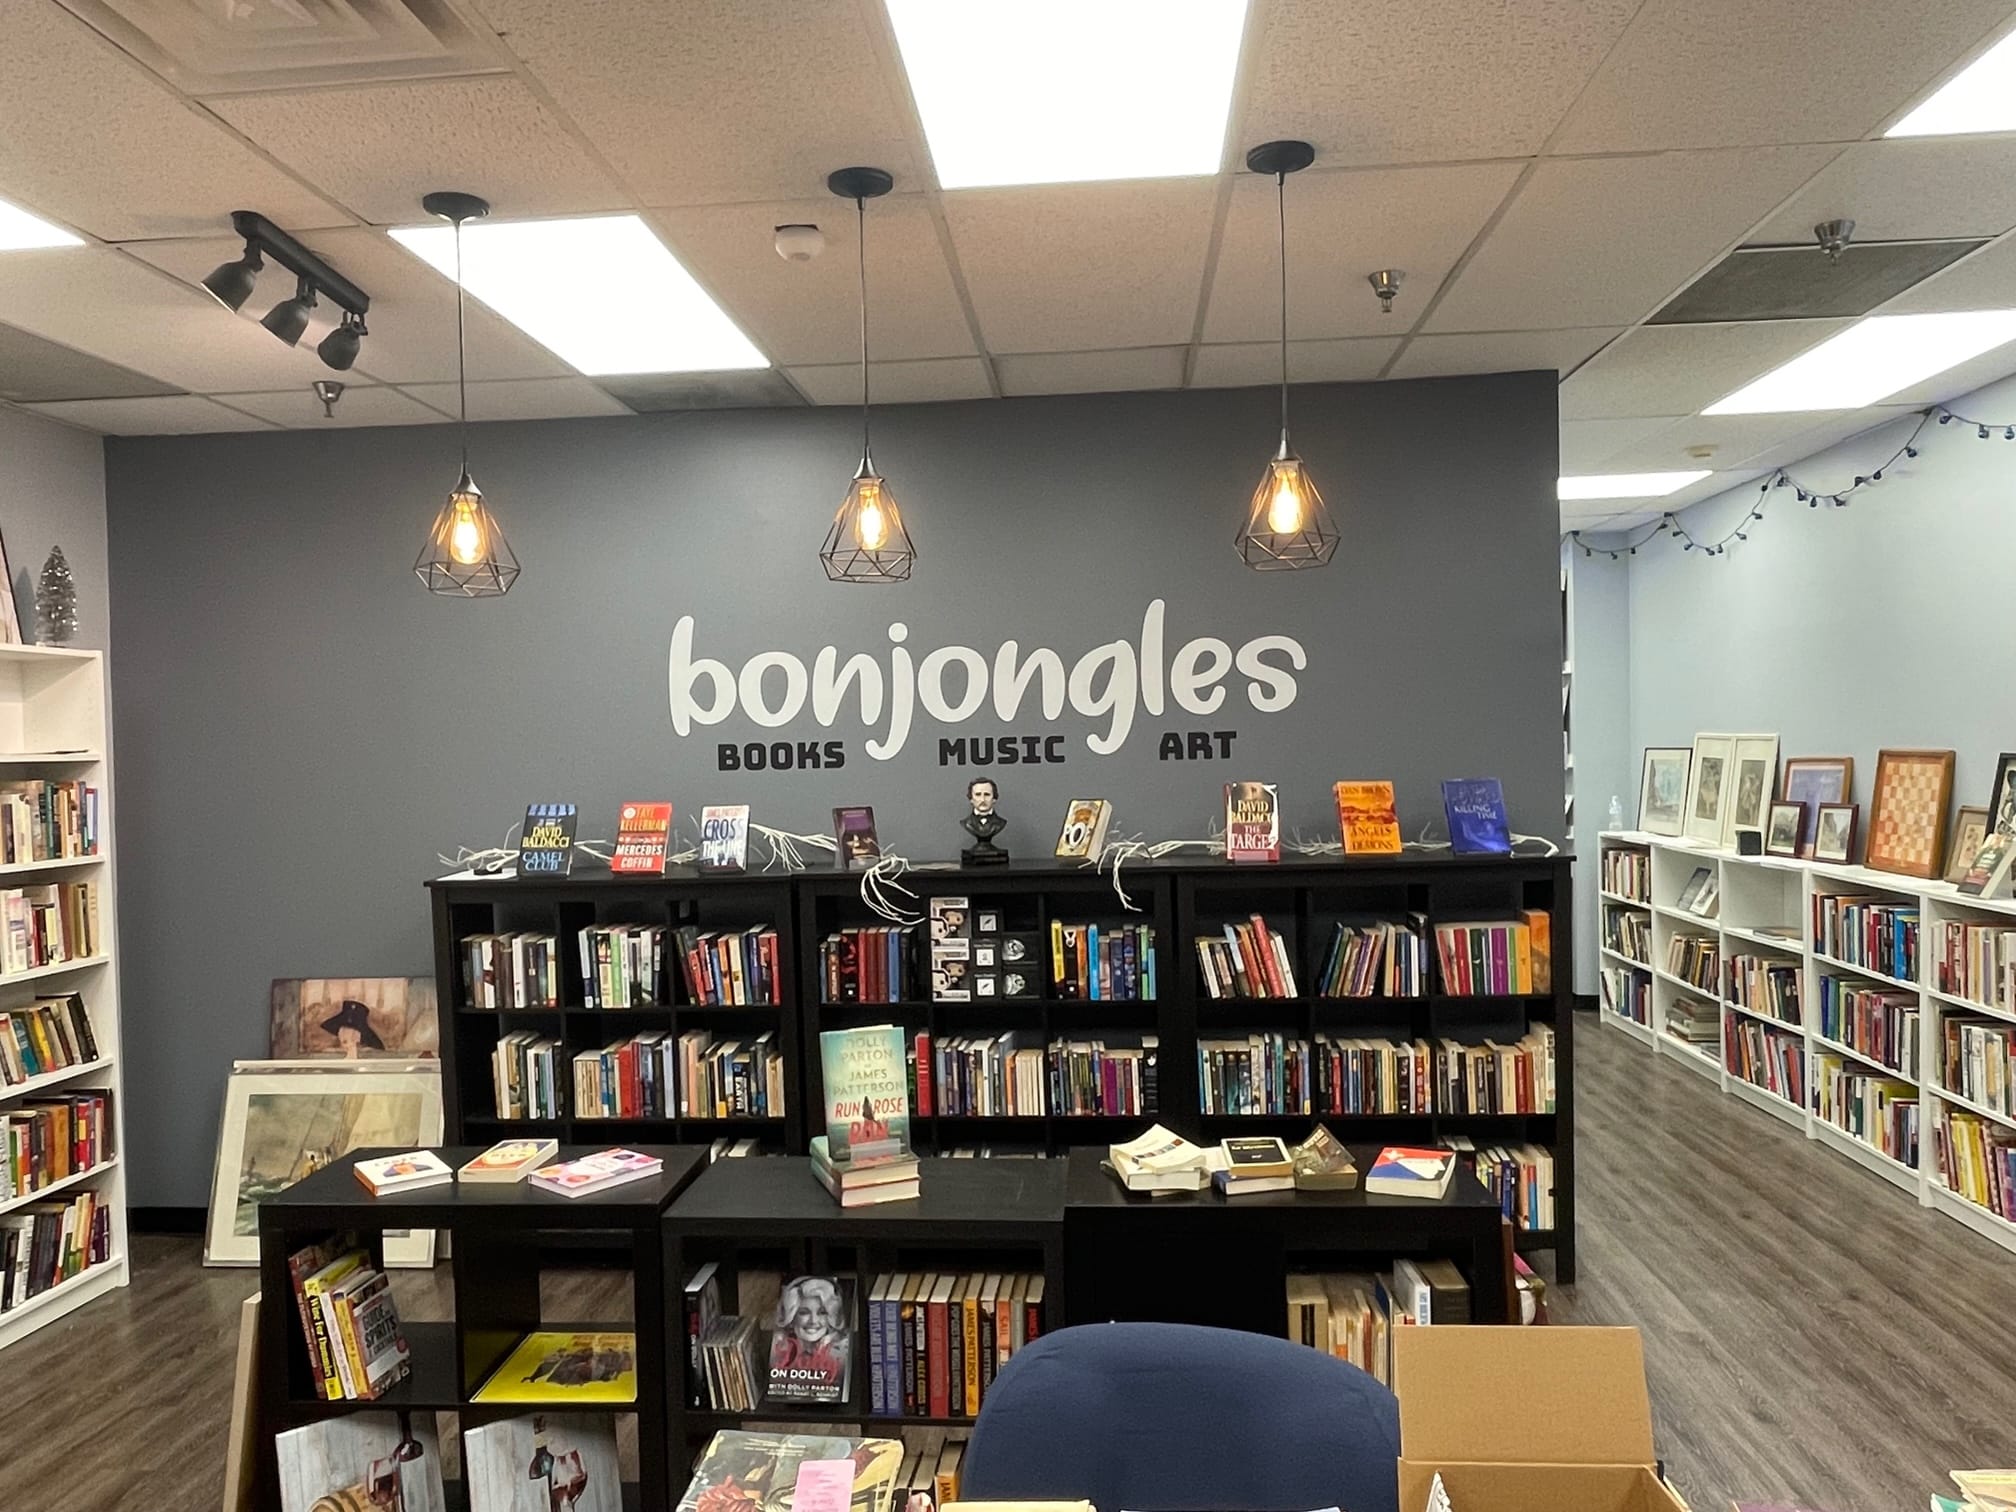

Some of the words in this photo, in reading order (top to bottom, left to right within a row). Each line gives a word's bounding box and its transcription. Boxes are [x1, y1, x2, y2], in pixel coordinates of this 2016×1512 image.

[668, 599, 1306, 760] bonjongles
[717, 741, 845, 771] BOOKS
[938, 735, 1066, 766] MUSIC
[1158, 730, 1237, 761] ART
[1238, 799, 1269, 812] DAVID
[532, 826, 562, 837] DAVID
[620, 819, 667, 832] KELLERMAN
[704, 817, 744, 841] CROSS
[1244, 825, 1260, 834] THE
[1350, 827, 1391, 837] ANGELS
[522, 836, 570, 848] BALDACCI
[522, 851, 564, 862] CAMEL
[615, 844, 663, 856] MERCEDES
[525, 860, 558, 871] CLUB
[620, 856, 653, 869] COFFIN
[841, 1048, 893, 1064] PARTON
[849, 1069, 888, 1082] JAMES
[833, 1081, 904, 1096] PATTERSON
[835, 1101, 860, 1118] RUN
[873, 1096, 903, 1115] ROSE
[966, 1307, 975, 1335] JAMES
[999, 1315, 1008, 1335] SAIL
[966, 1335, 976, 1386] PATTERSON
[770, 1368, 787, 1378] ON
[790, 1369, 827, 1380] DOLLY
